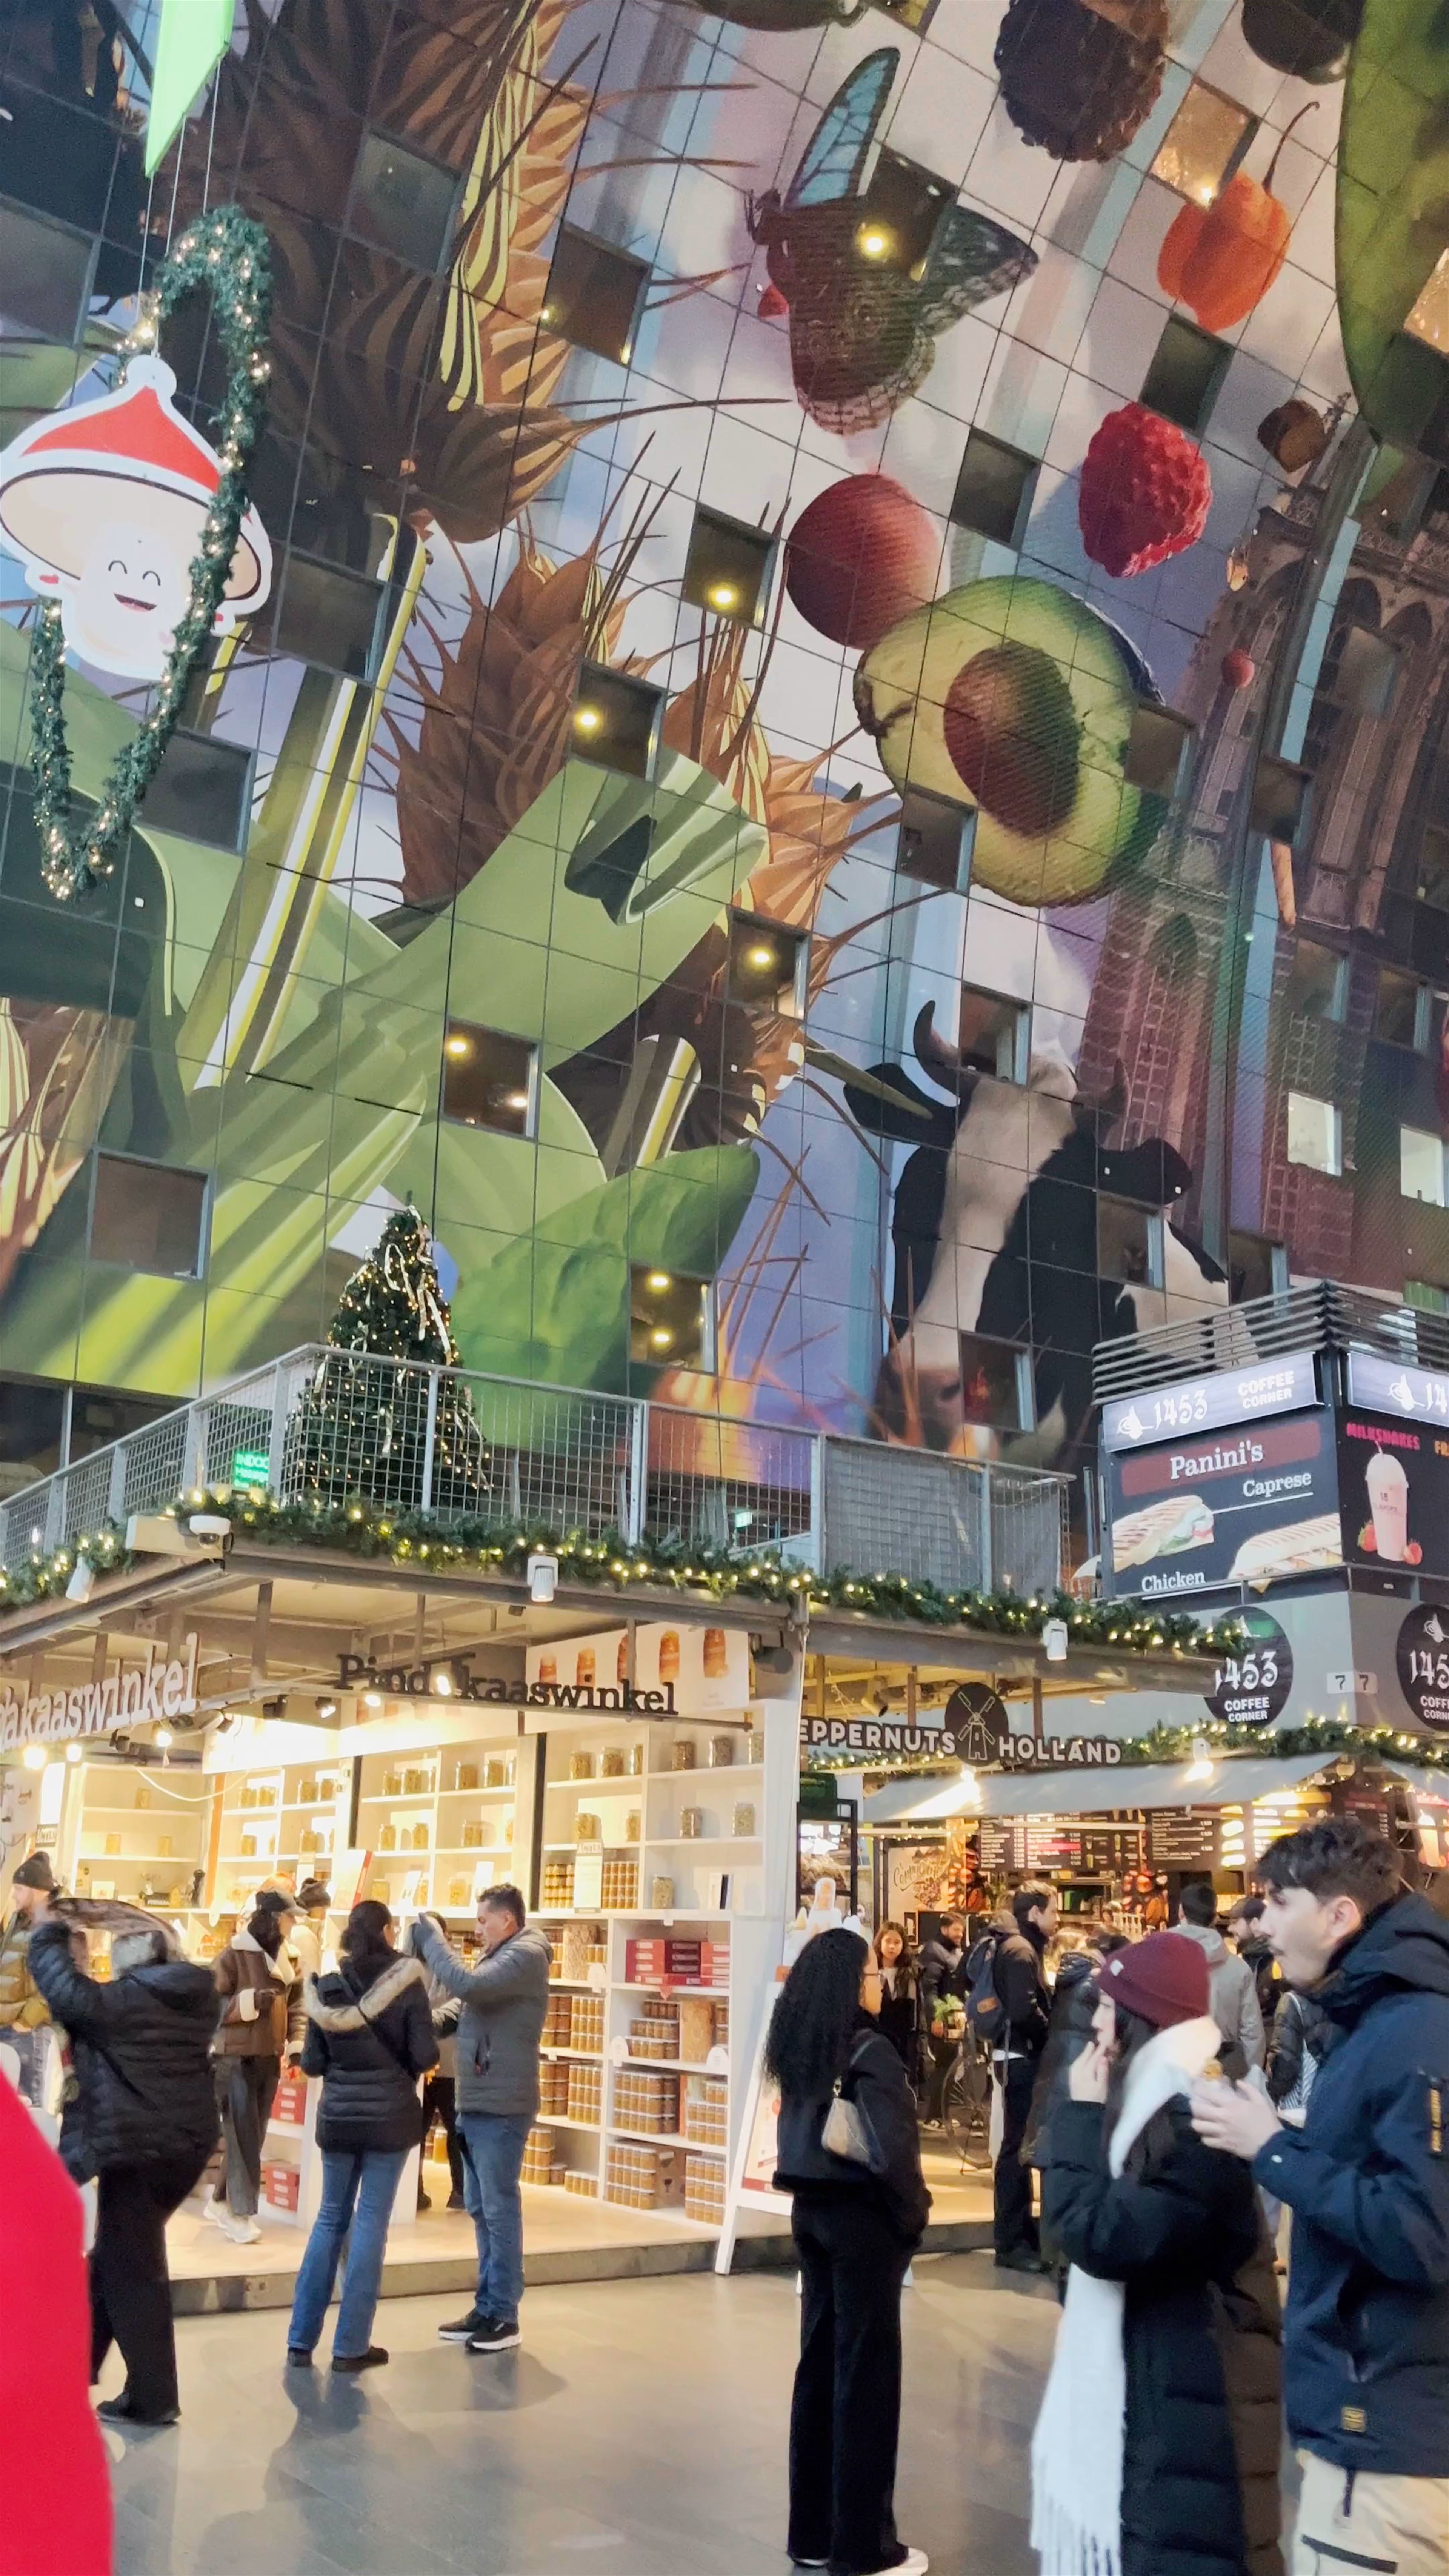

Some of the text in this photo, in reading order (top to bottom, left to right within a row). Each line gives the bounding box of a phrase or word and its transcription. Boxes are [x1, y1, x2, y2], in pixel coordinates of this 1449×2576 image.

[1238, 1370, 1295, 1396] COFFEE
[1242, 1388, 1292, 1409] CORNER
[1153, 1389, 1208, 1430] 1453
[1170, 1440, 1263, 1479] Panini's
[1243, 1472, 1312, 1497] Caprese
[1141, 1571, 1207, 1592] Chicken
[1335, 1675, 1346, 1690] 7
[1359, 1674, 1369, 1690] 7
[1224, 1697, 1270, 1712] COFFEE
[1420, 1695, 1449, 1709] COFF
[1228, 1710, 1267, 1722] CORNER
[1424, 1709, 1449, 1720] CORN
[999, 1736, 1121, 1764] HOLLAND
